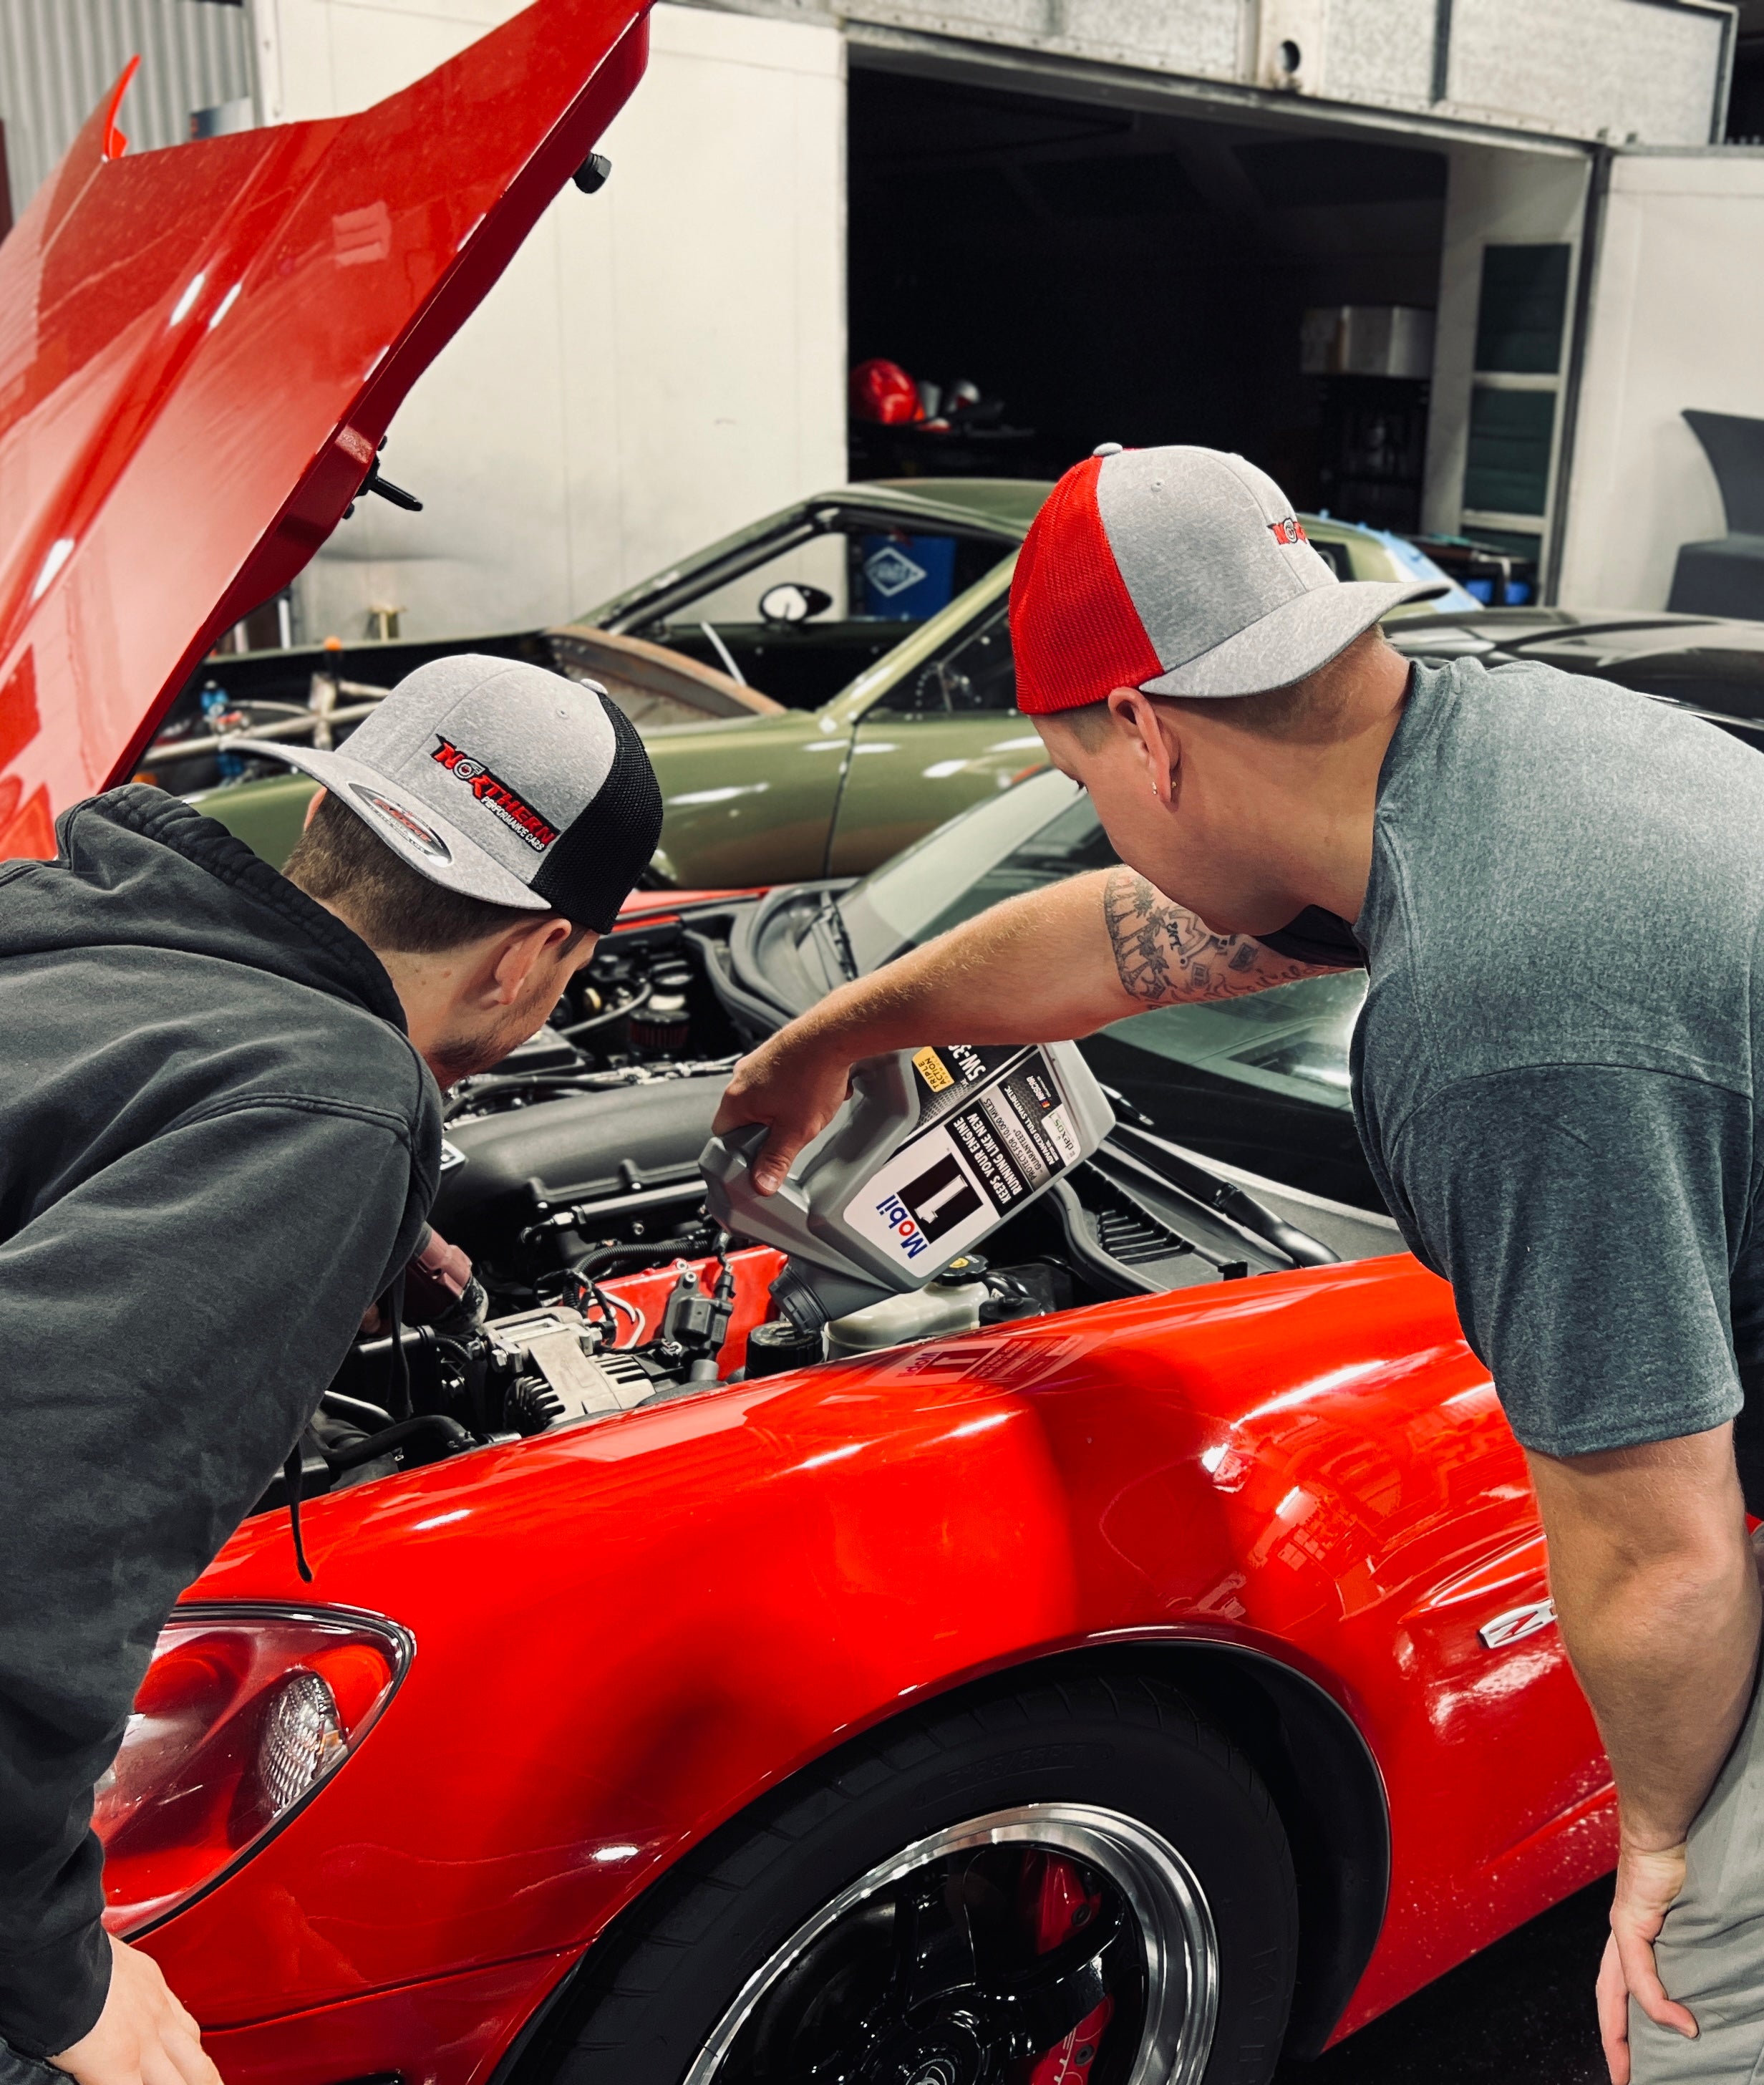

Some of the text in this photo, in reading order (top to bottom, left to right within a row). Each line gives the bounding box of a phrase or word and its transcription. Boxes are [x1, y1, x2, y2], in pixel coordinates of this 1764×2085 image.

[433, 740, 556, 846] NORTHERN
[480, 797, 546, 851] PERFORMANCE CARS
[918, 1060, 939, 1089] TRIPLE
[925, 1058, 946, 1084] ACTION
[1026, 1075, 1046, 1100] NASCAR
[966, 1113, 1022, 1195] RUNNING LIKE NEW
[983, 1098, 1037, 1181] PROTECTS FOR 10,000 MILES
[1004, 1085, 1055, 1165] ADVANCED FULL SYNTHETIC
[954, 1116, 1011, 1204] KEEPS YOUR ENGINE
[876, 1194, 928, 1259] Mobil
[914, 1174, 968, 1224] 1
